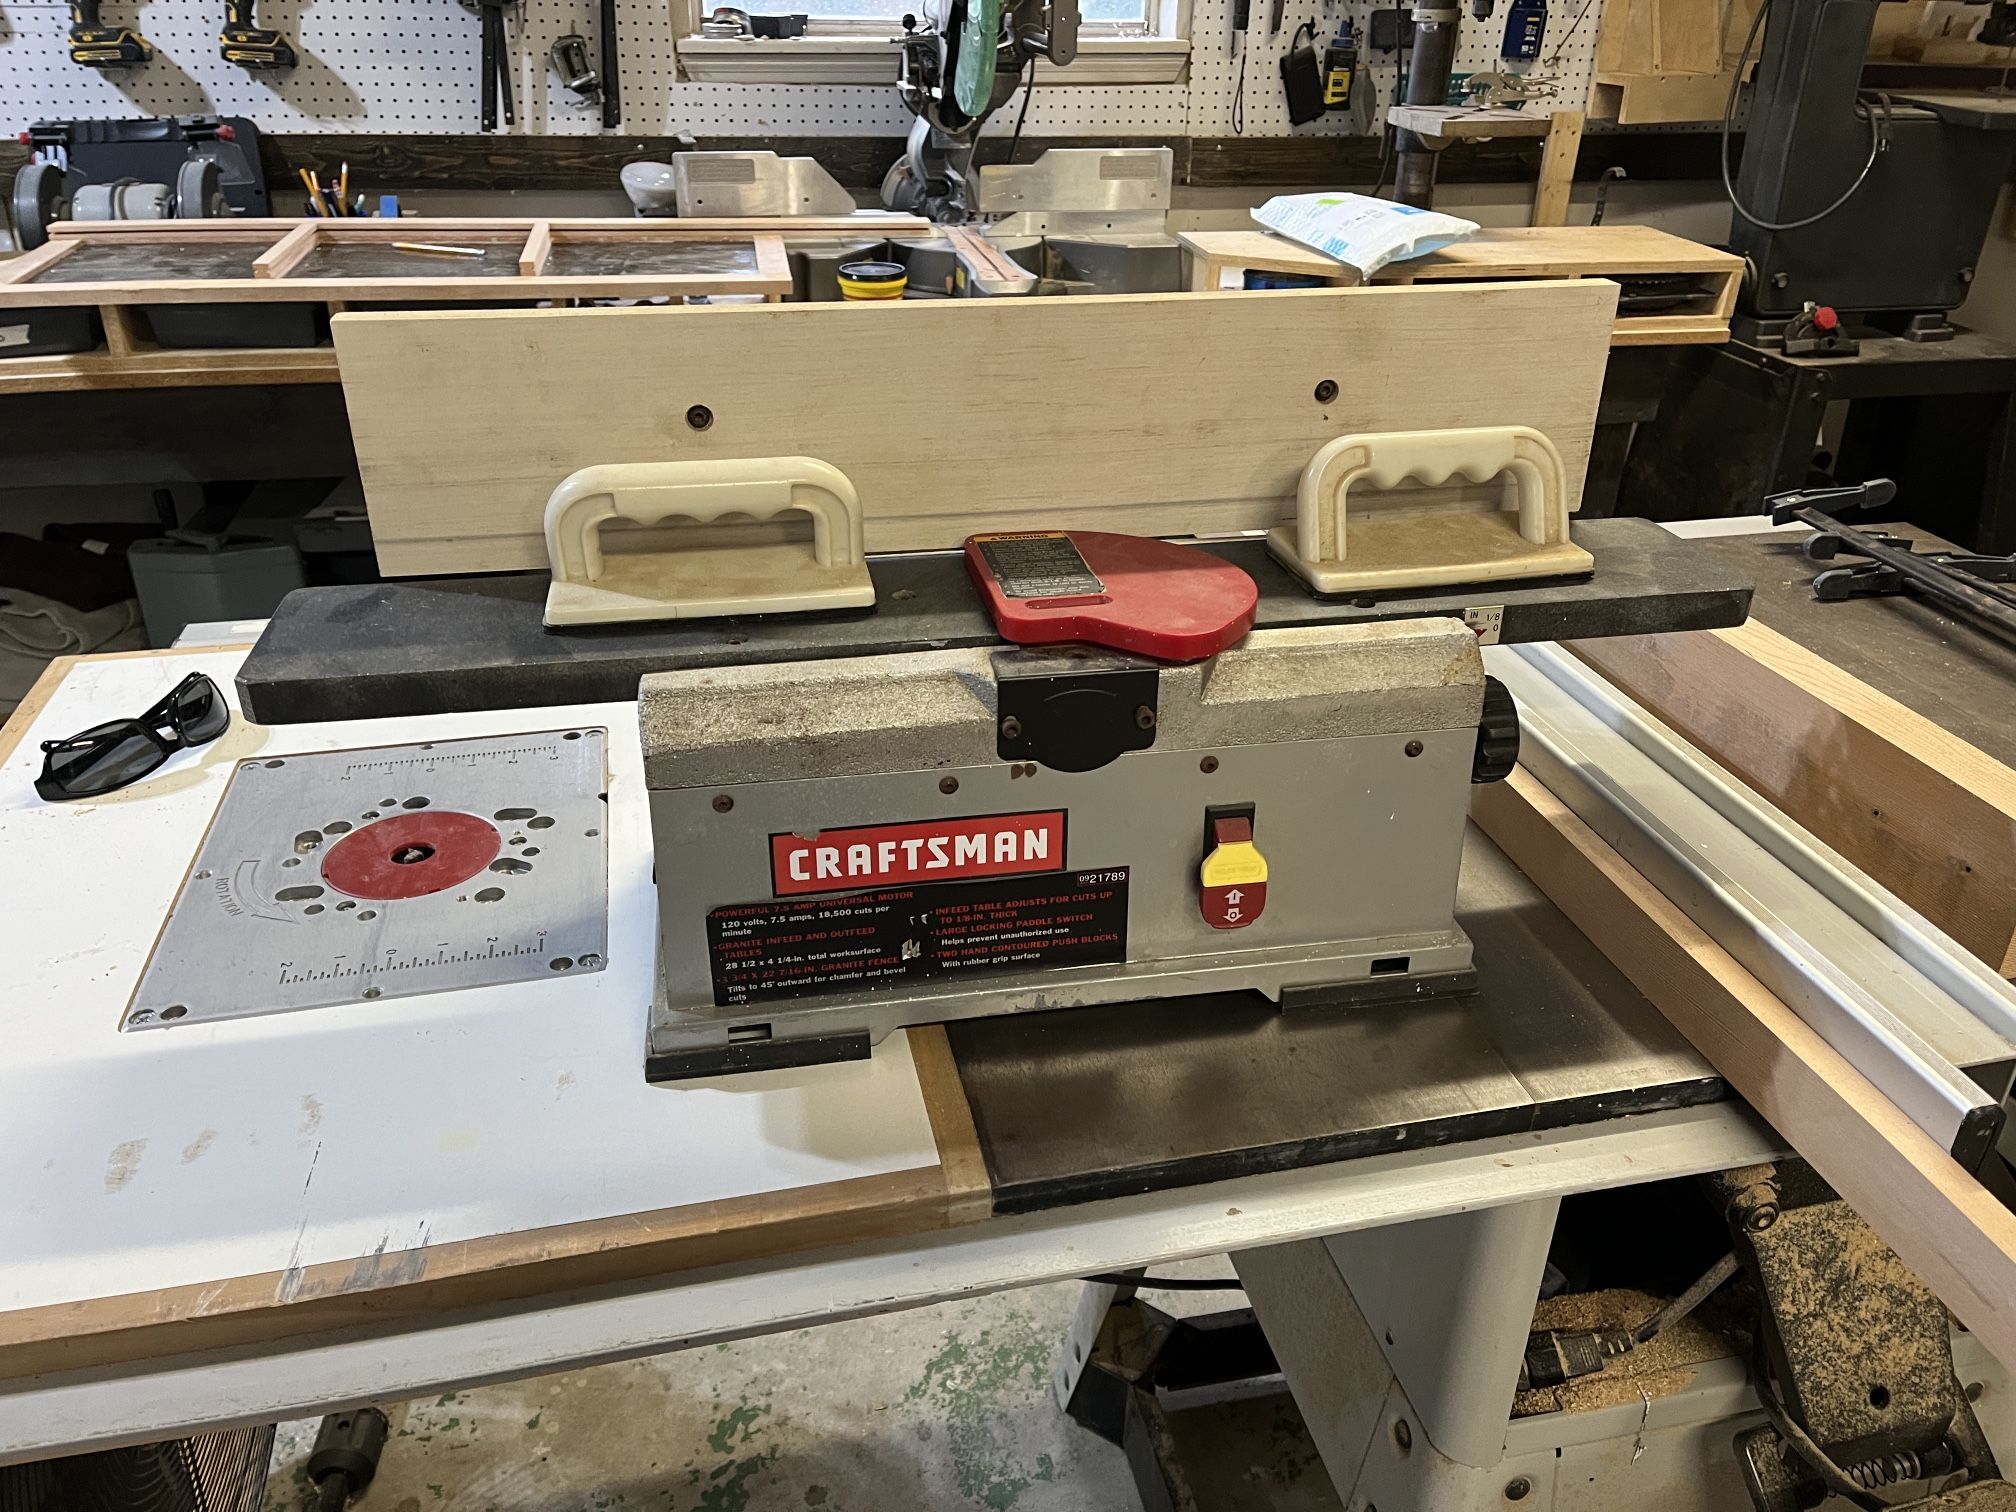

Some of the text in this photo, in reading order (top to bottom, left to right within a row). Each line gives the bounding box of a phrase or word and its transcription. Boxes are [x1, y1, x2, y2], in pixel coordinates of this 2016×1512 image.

[1470, 611, 1500, 621] IN 1/8
[789, 828, 1048, 881] CRAFTSMAN
[216, 877, 244, 917] ROTATION
[715, 906, 769, 918] POWERFUL
[794, 902, 816, 910] AMP
[819, 896, 875, 907] UNIVERSAL
[878, 891, 913, 901] MOTOR
[935, 891, 1113, 915] INFEED TABLE ADJUSTS FOR CUTS UP
[722, 920, 740, 929] 120
[744, 918, 767, 926] volts,
[789, 913, 815, 922] amps,
[819, 909, 851, 918] 18,500
[854, 907, 873, 915] cuts
[876, 906, 890, 914] per
[935, 913, 1093, 936] LARGE LOCKING PADDLE SWITCH
[941, 916, 953, 925] TO
[990, 910, 1018, 919] THICK
[718, 927, 876, 950] GRANITE INFEED AND OUTFEED
[722, 928, 752, 937] minute
[941, 938, 964, 946] Helps
[967, 934, 998, 944] prevent
[1001, 928, 1052, 939] unauthorized
[725, 949, 762, 959] TABLES
[937, 933, 1118, 958] TWO HAND CONTOURED PUSH BLOCKS
[726, 962, 738, 970] 28
[742, 960, 756, 968] 1/2
[829, 947, 881, 957] worksurface
[763, 970, 774, 978] 22
[821, 960, 865, 971] GRANITE
[868, 956, 900, 966] FENCE
[941, 952, 1040, 968] With rubber grip surface
[728, 984, 746, 993] Tilts
[777, 976, 811, 987] outward
[829, 972, 863, 981] chamfer
[866, 968, 881, 977] and
[884, 966, 906, 975] bevel
[728, 993, 747, 1002] cuts
